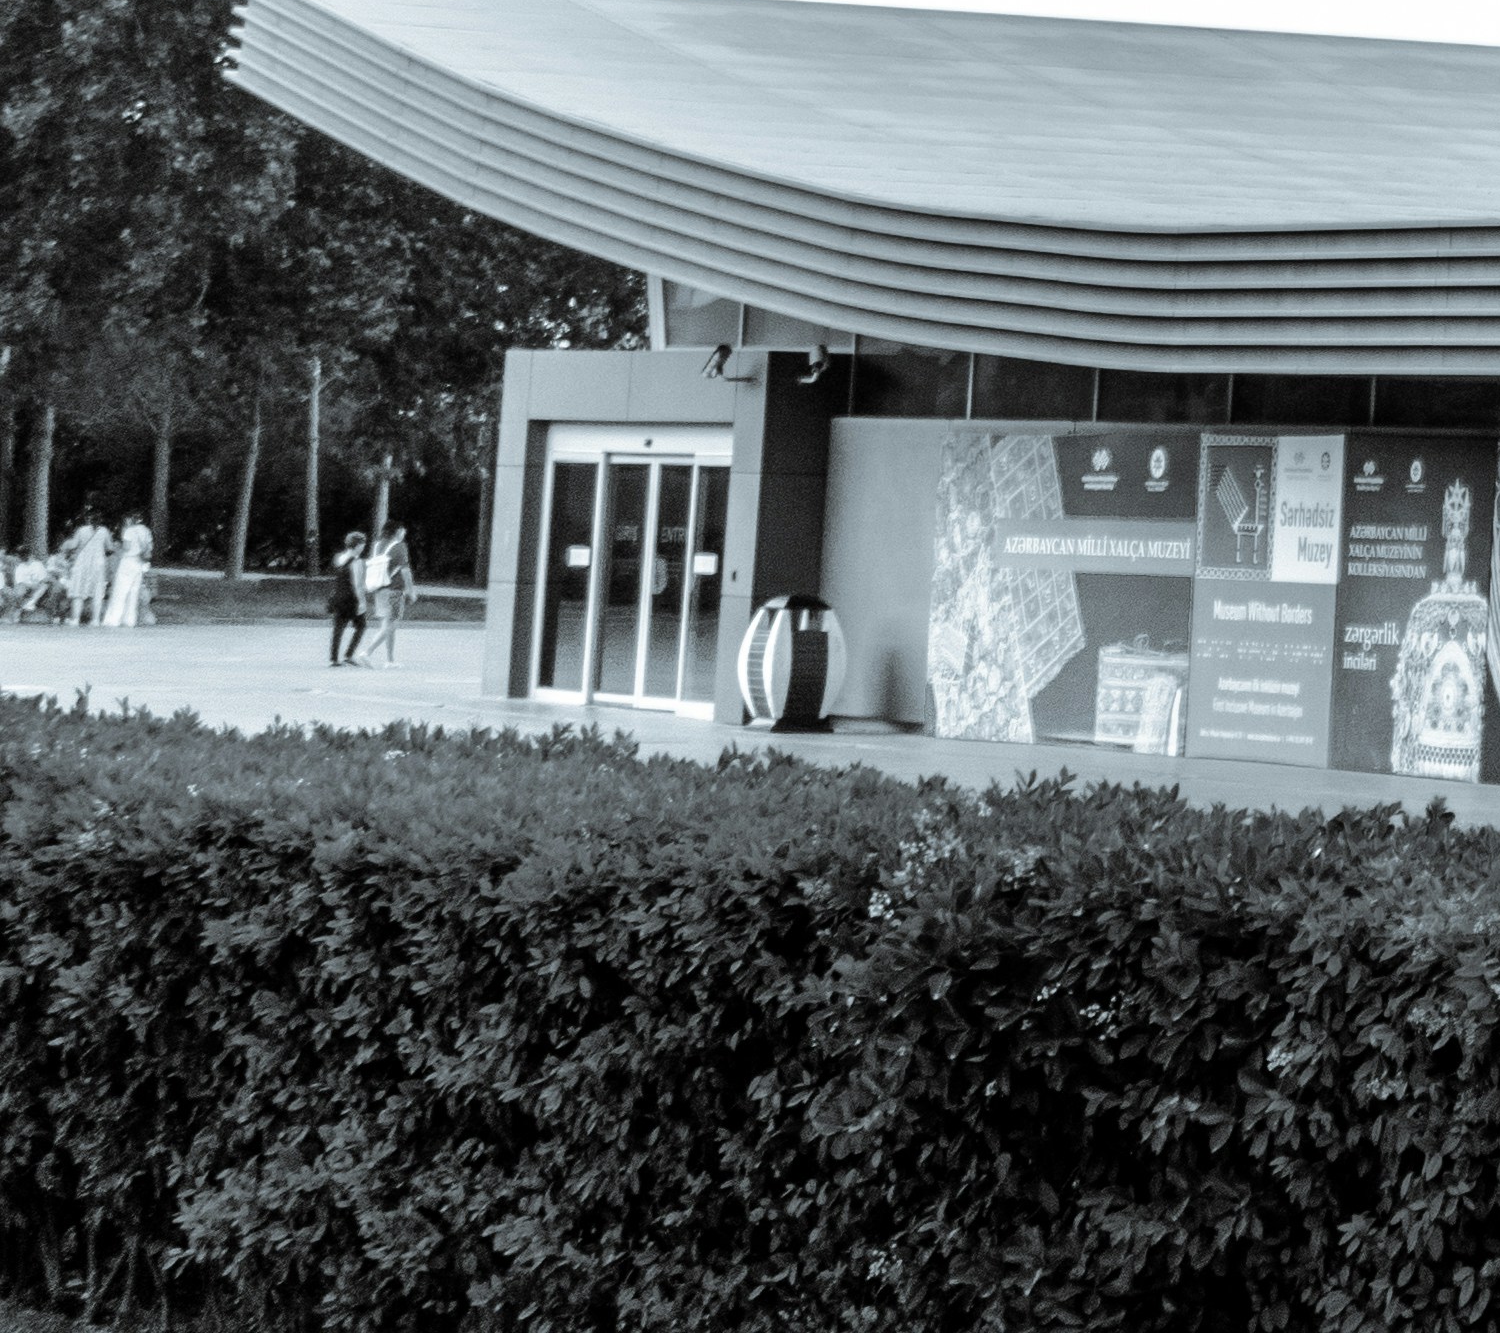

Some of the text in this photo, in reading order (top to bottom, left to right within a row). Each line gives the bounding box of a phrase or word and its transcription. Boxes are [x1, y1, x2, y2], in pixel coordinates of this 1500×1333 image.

[1280, 501, 1335, 528] Sərhədsiz
[1003, 535, 1191, 562] AZƏRBAYCAN MİLLİ XALÇA MUZEYİ
[1297, 536, 1333, 569] Muzey
[1344, 622, 1399, 652] zərgərlik
